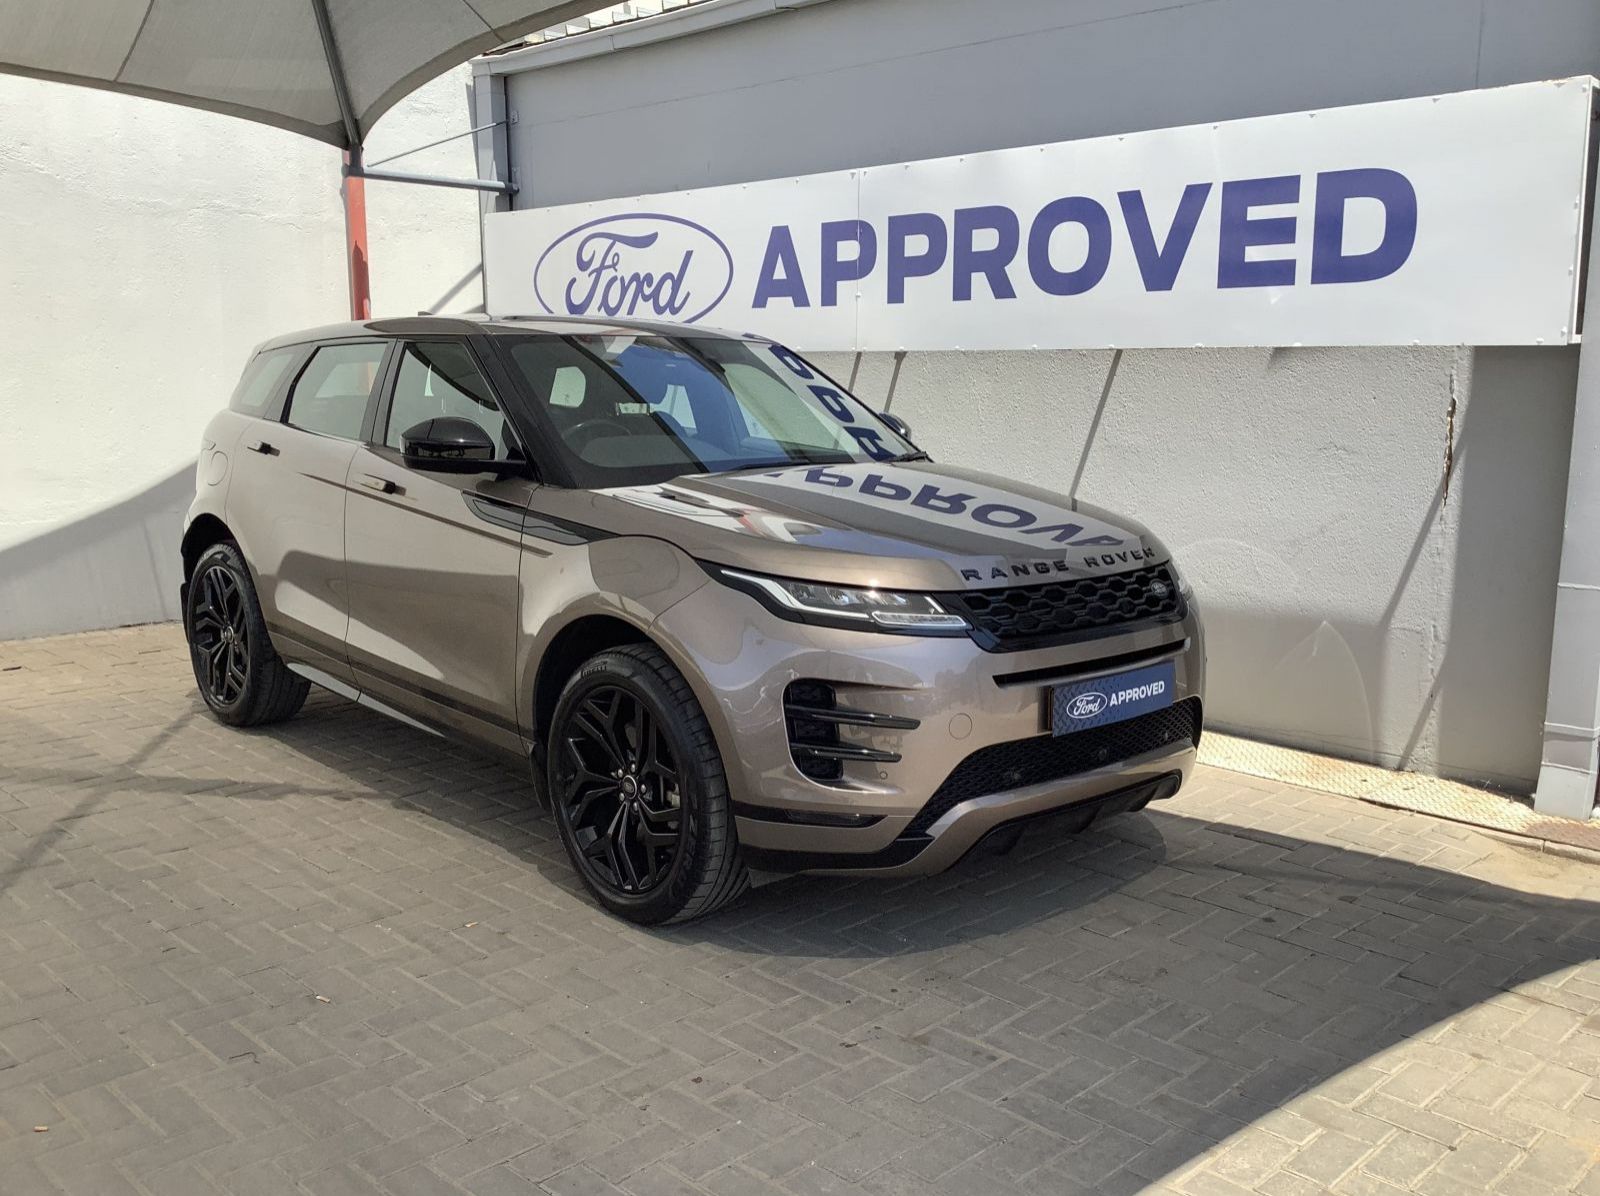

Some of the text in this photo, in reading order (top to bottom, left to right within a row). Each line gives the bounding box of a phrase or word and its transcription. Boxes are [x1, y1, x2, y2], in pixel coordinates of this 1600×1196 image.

[565, 167, 1418, 316] Ford APPROVED
[961, 546, 1156, 581] RANGE ROVER
[1073, 680, 1165, 716] Ford APPROVED
